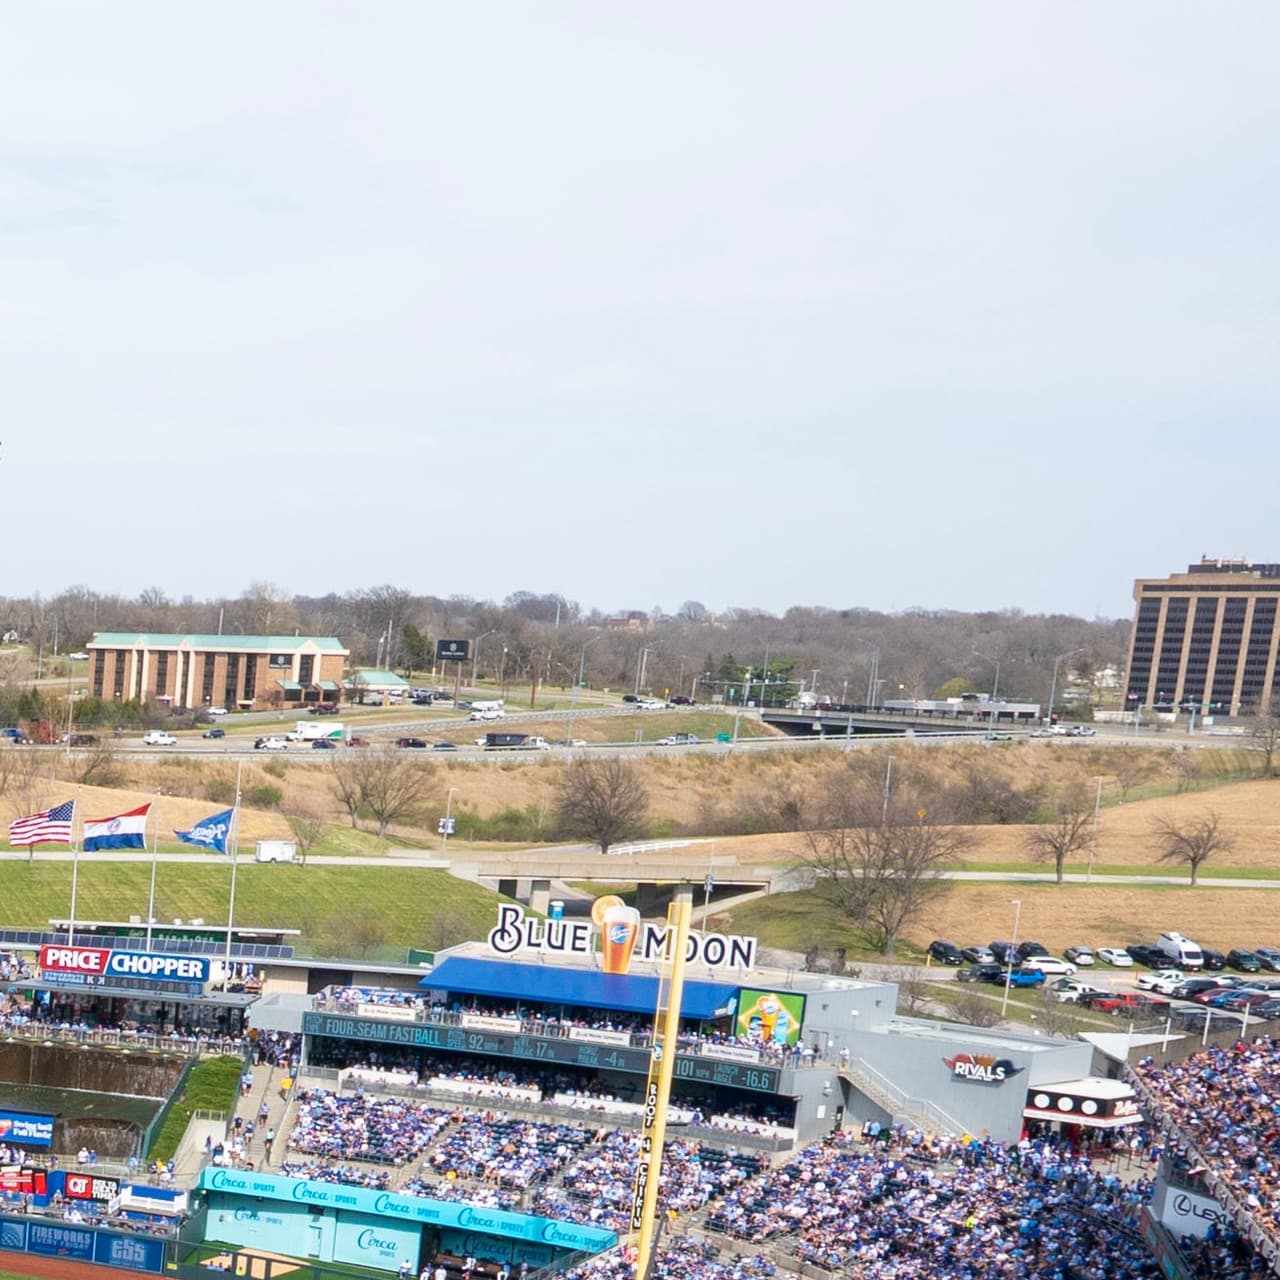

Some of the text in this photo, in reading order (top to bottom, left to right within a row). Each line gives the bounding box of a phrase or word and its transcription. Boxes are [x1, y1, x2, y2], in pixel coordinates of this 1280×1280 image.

[491, 906, 753, 968] BLUE MOON
[46, 949, 101, 970] PRICE
[111, 954, 204, 979] CHOPPER
[326, 1019, 770, 1089] FOUR-SEAM FASTBALL 92 101 -16.6
[954, 1062, 1006, 1081] RIVALS
[646, 1084, 658, 1127] ROOT
[211, 1169, 275, 1194] Circa SPORTS
[292, 1181, 329, 1202] Circa
[374, 1193, 411, 1215] Circa
[633, 1164, 648, 1228] CHIKIN
[31, 1225, 90, 1243] FIREWORKS
[357, 1228, 398, 1251] Circa
